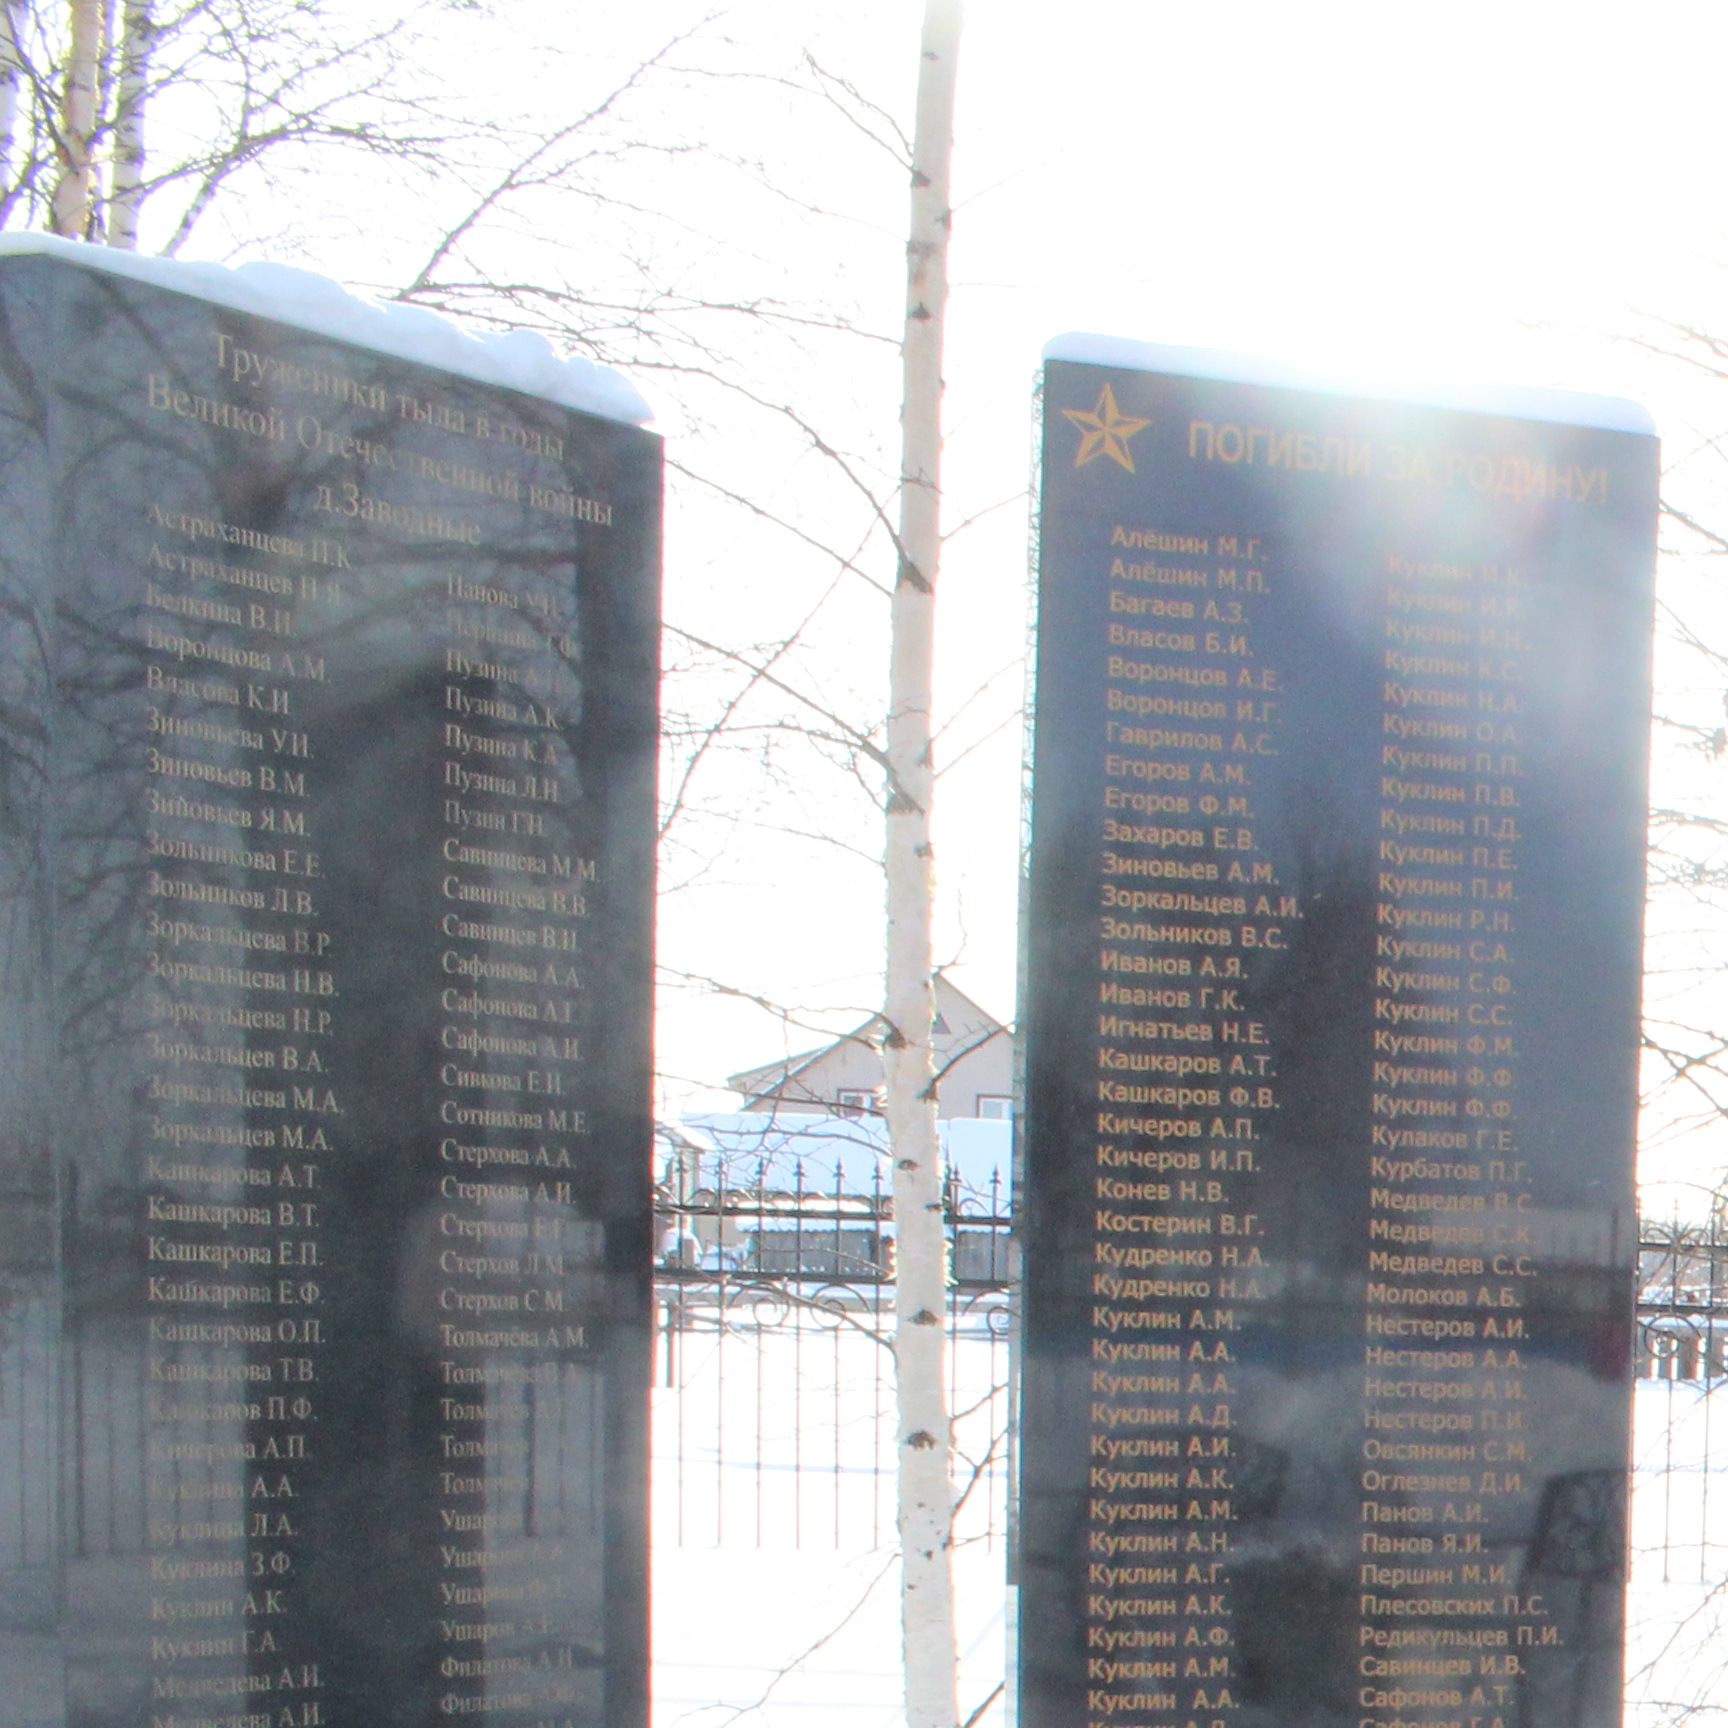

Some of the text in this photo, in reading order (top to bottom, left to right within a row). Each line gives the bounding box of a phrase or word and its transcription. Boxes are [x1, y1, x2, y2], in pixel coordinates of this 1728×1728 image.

[212, 332, 563, 461] Труженики тыла в годы
[149, 374, 285, 441] Великой
[529, 485, 612, 526] войны
[1188, 421, 1607, 502] ПОГИБЛИ ЗА РОДИНУ!
[1108, 623, 1252, 655] Власов Б.И.
[147, 749, 252, 787] Зиновьев
[1104, 786, 1253, 817] Егоров Ф.М.
[1103, 819, 1258, 850] Захаров Е.В.
[1102, 852, 1278, 883] Зиновьев А.М.
[1102, 884, 1303, 918] Зоркальцев А.И.
[1376, 903, 1514, 931] Куклин Р.Н.
[1101, 917, 1287, 949] Зольников В.С.
[1100, 983, 1244, 1010] Иванов Г.К.
[1099, 1048, 1276, 1076] Кашкаров А.Т.
[1098, 1081, 1279, 1108] Кашкаров Ф.В.
[1097, 1113, 1259, 1139] Кичеров А.П.
[1371, 1125, 1517, 1150] Кулаков Г.Е.
[1096, 1177, 1228, 1202] Конев Н.В.
[1096, 1210, 1263, 1235] Костерин В.Г.
[148, 1236, 270, 1268] Кашкарова
[148, 1276, 270, 1307] Кашкарова
[1367, 1283, 1521, 1307] Молоков А.Б.
[1365, 1314, 1528, 1338] Нестеров А.И.
[1090, 1468, 1233, 1490] Куклин А.К.
[1359, 1594, 1547, 1615] Плесовских П.С.
[1088, 1626, 1234, 1649] Куклин А.Ф.
[1358, 1625, 1563, 1646] Редикульцев П.И.
[1357, 1684, 1514, 1708] Сафонов А.Т.
